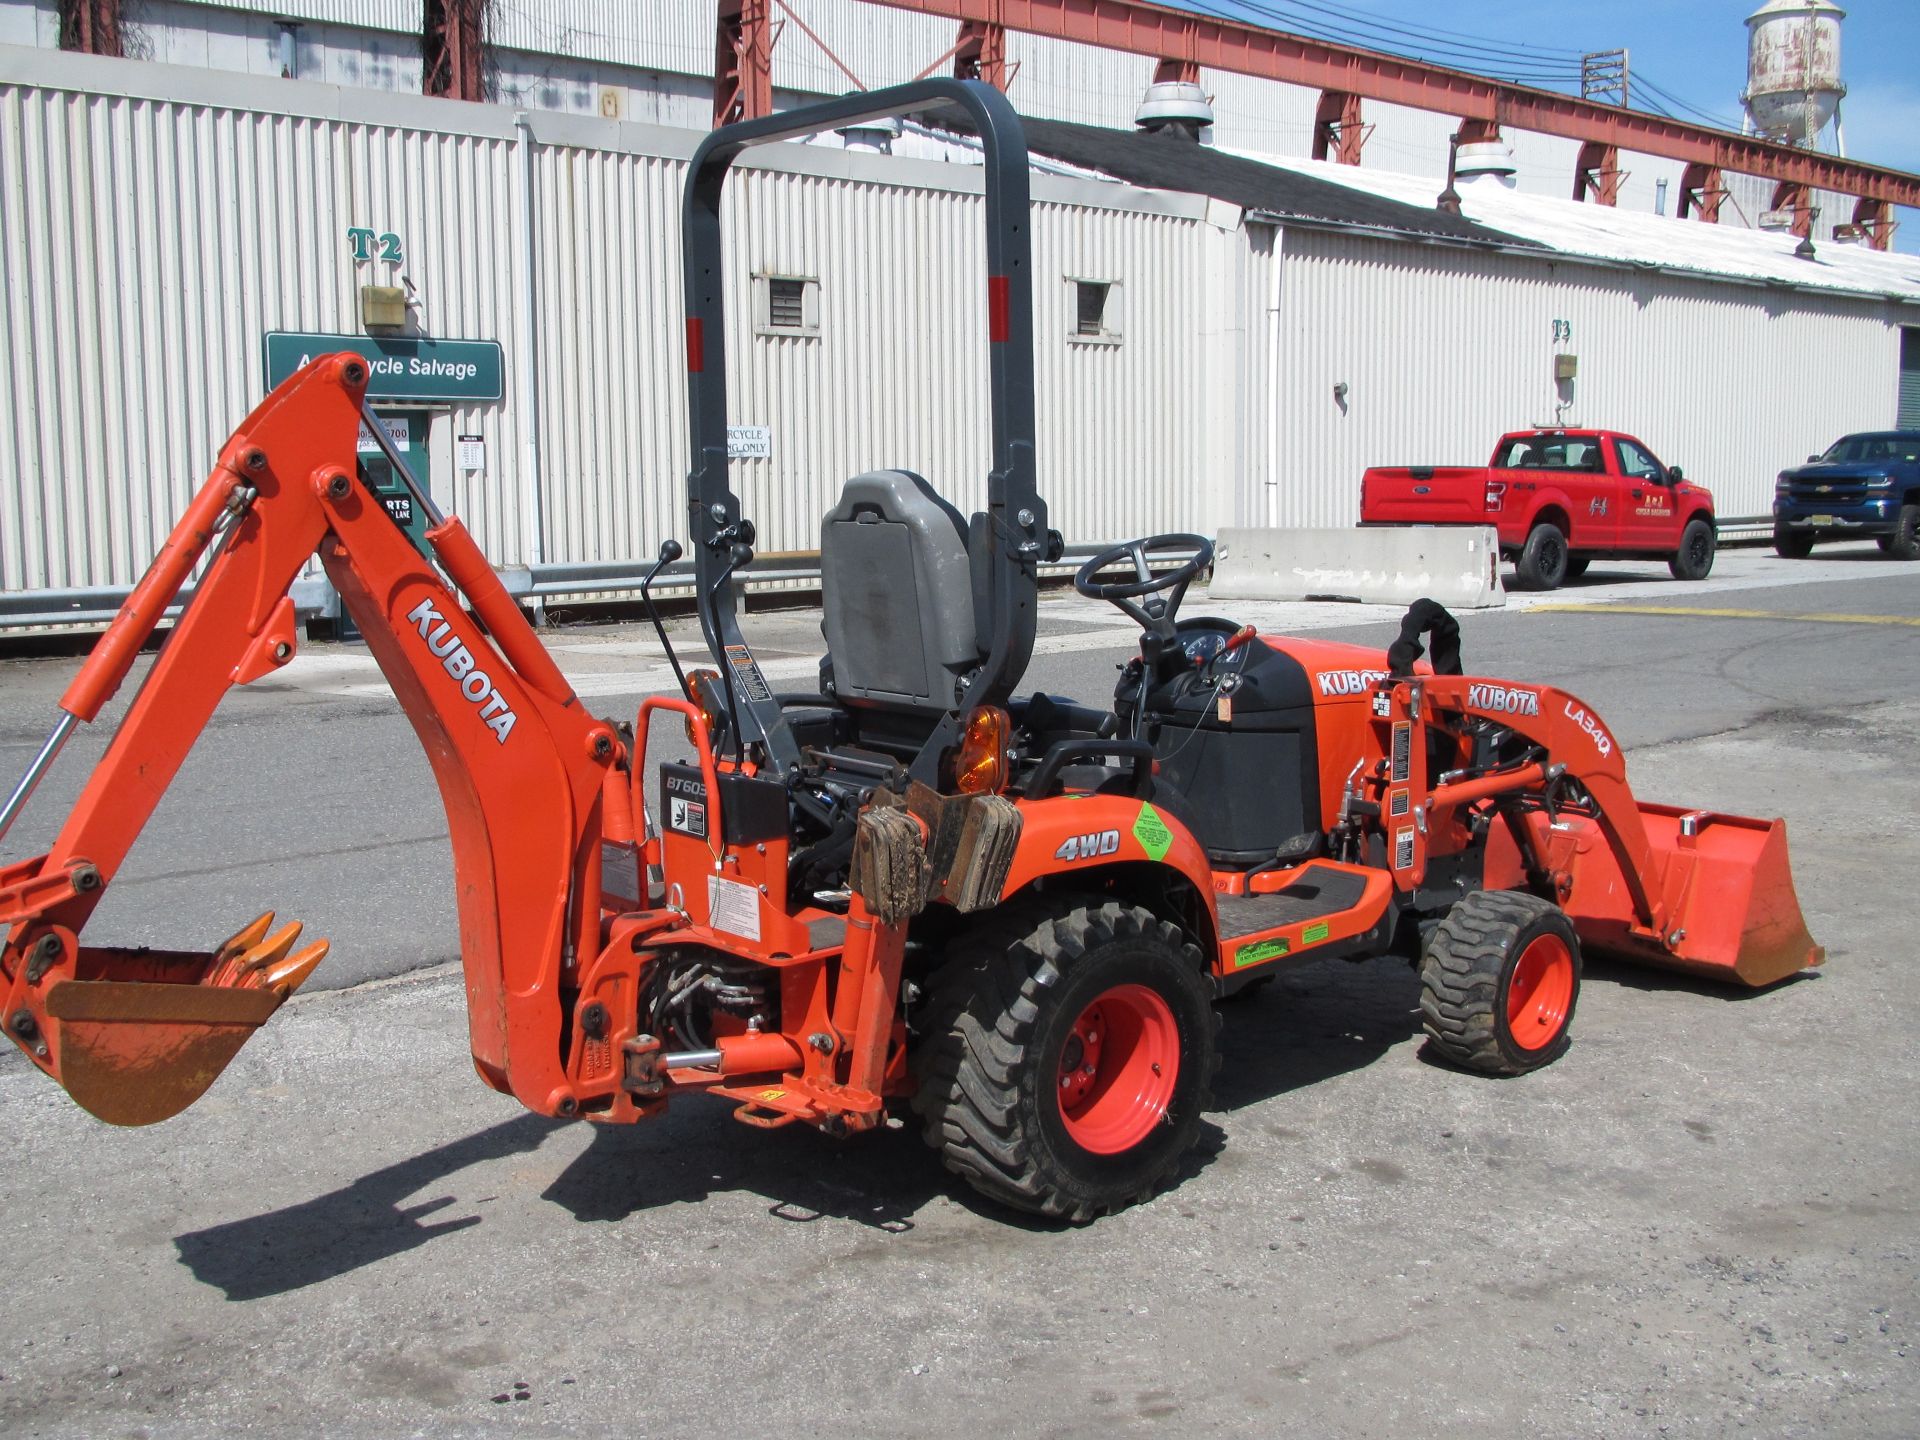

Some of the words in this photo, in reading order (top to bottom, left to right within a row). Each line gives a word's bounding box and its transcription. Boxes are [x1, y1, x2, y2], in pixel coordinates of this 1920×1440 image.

[365, 357, 404, 378] ycle
[409, 358, 477, 381] Salvage
[727, 429, 763, 440] RCYCLE
[742, 443, 767, 453] ONLY
[386, 499, 410, 510] RTS
[395, 510, 411, 519] LANE
[406, 597, 518, 745] KUBOTA
[1317, 670, 1392, 696] KUBOT
[1467, 684, 1539, 717] KUBOTA
[1055, 829, 1120, 862] 4WD
